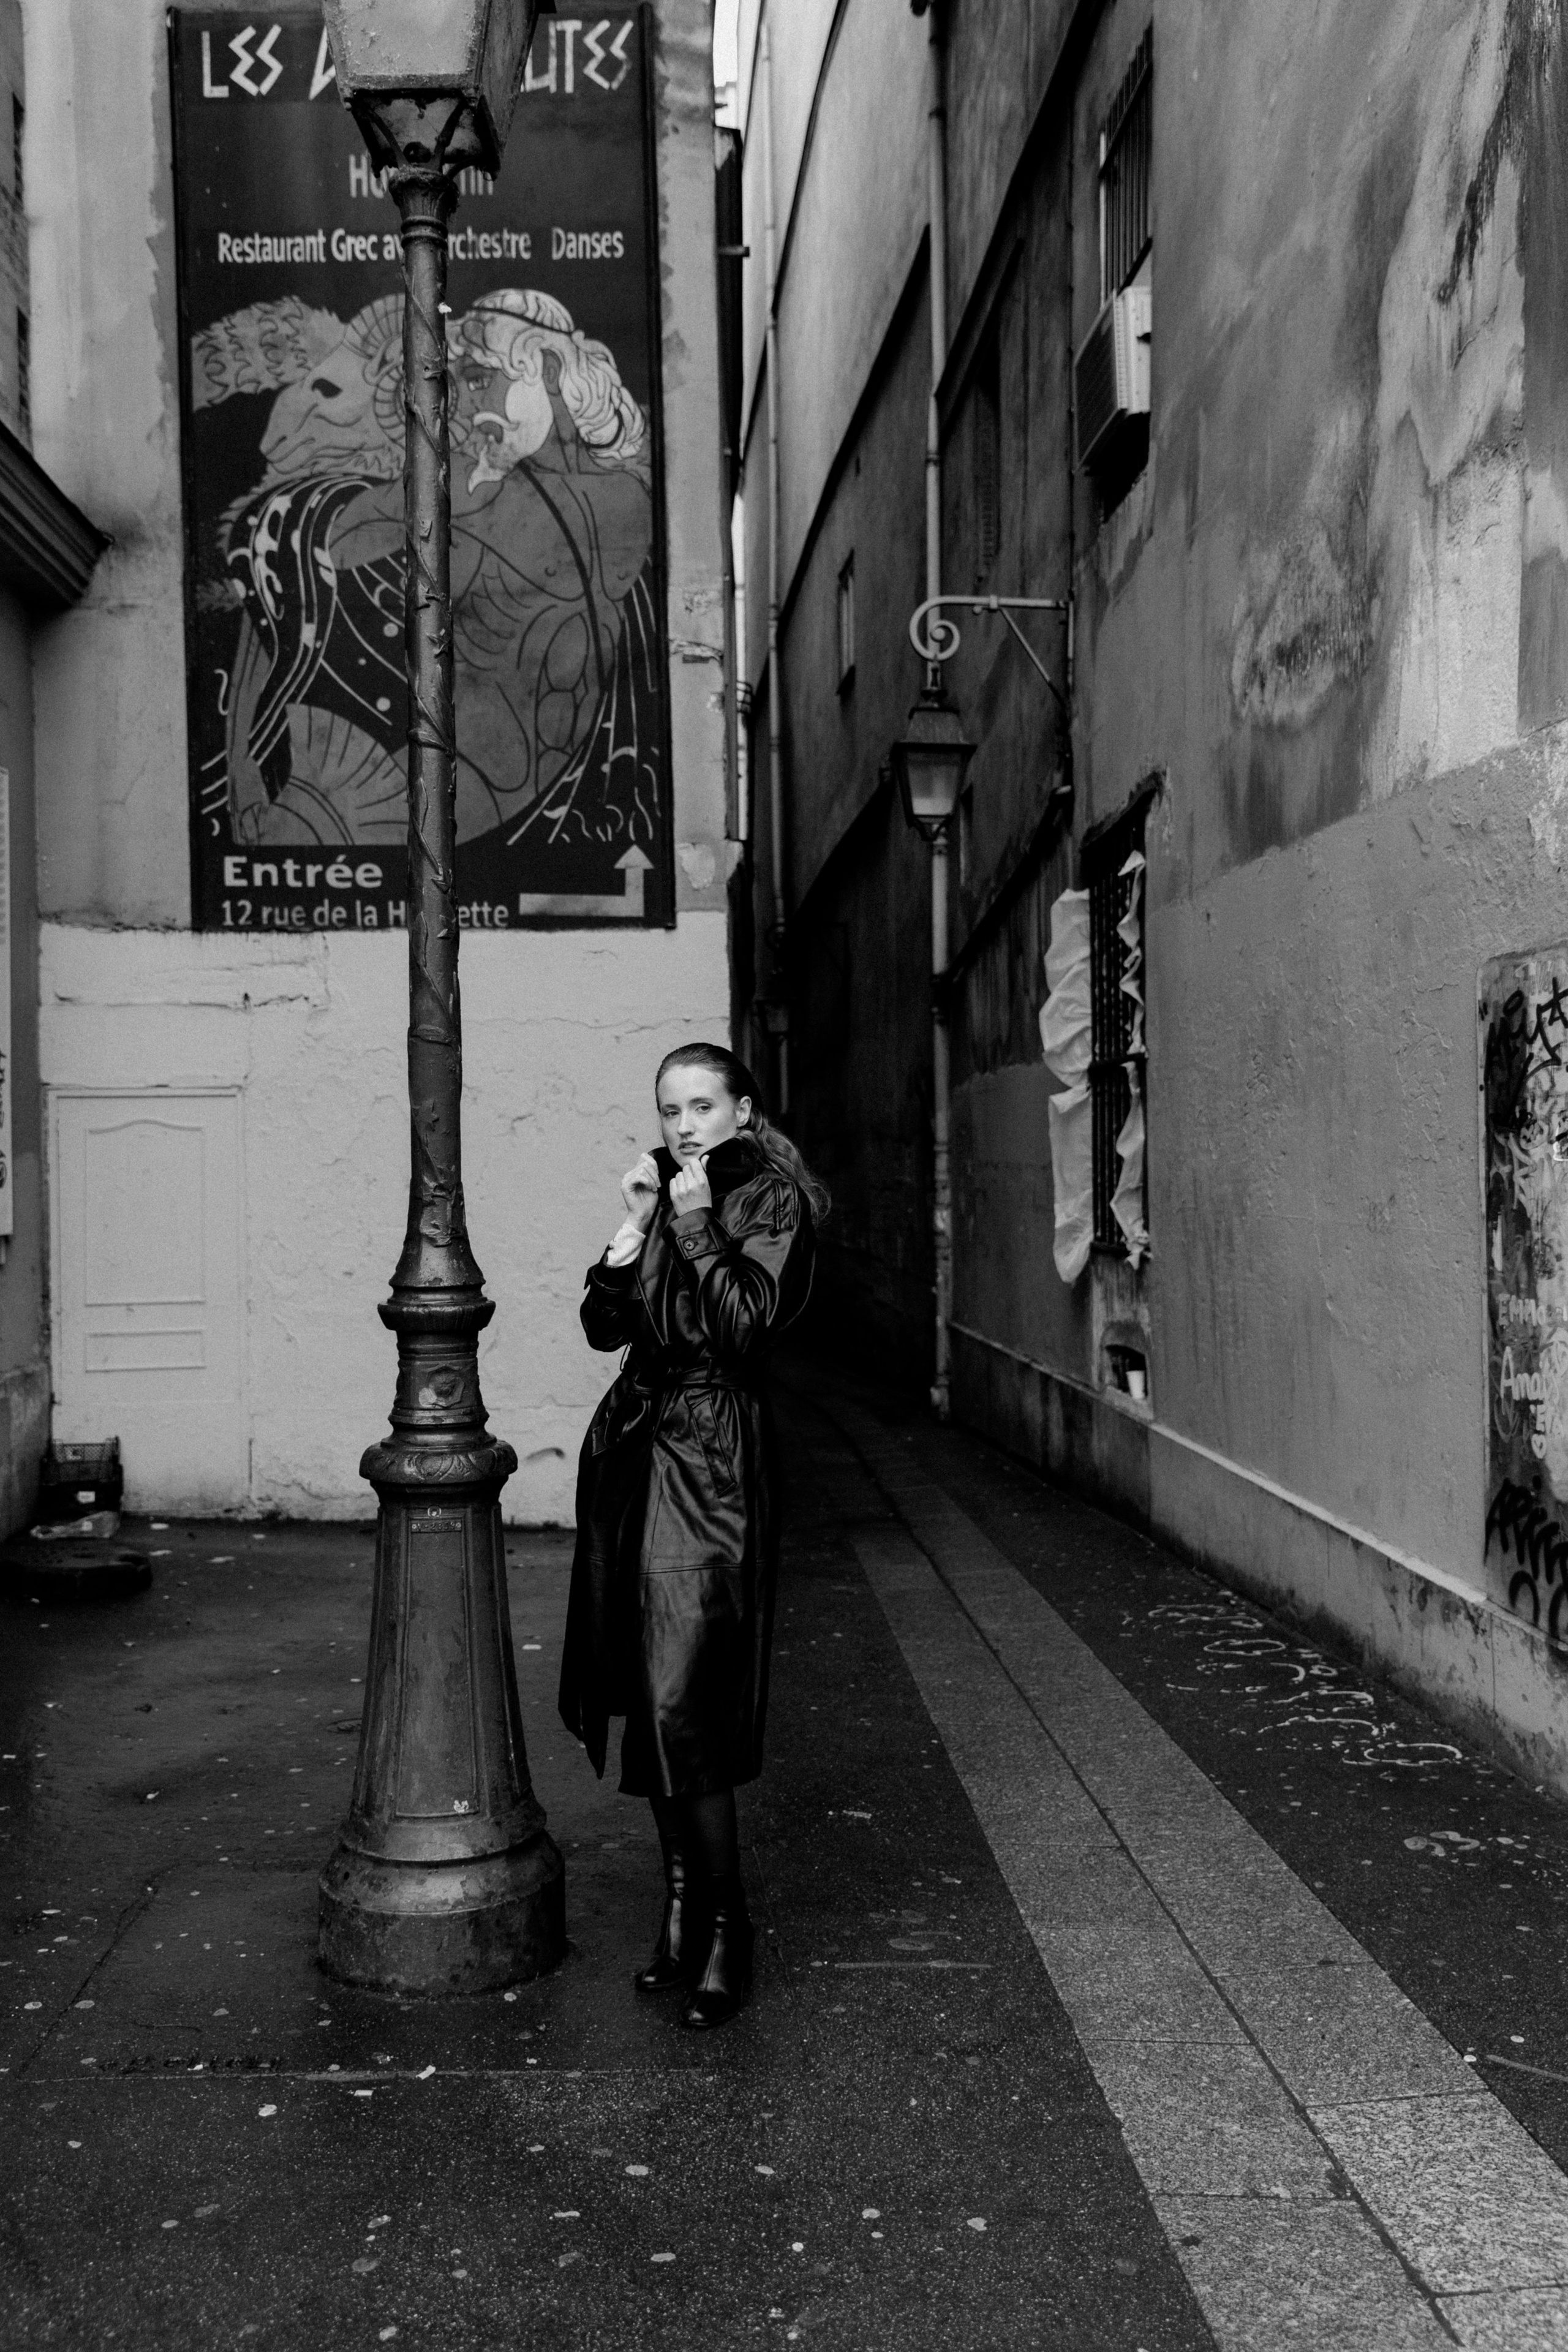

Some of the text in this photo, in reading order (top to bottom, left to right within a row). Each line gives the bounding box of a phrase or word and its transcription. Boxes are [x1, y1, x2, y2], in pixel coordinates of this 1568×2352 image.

[201, 23, 284, 98] LES
[218, 228, 326, 263] Restaurant
[331, 227, 379, 262] Grec
[447, 225, 532, 260] rchestre
[551, 226, 625, 260] Danses
[223, 854, 383, 889] Entrée
[221, 897, 510, 928] 12 rue de la Hette
